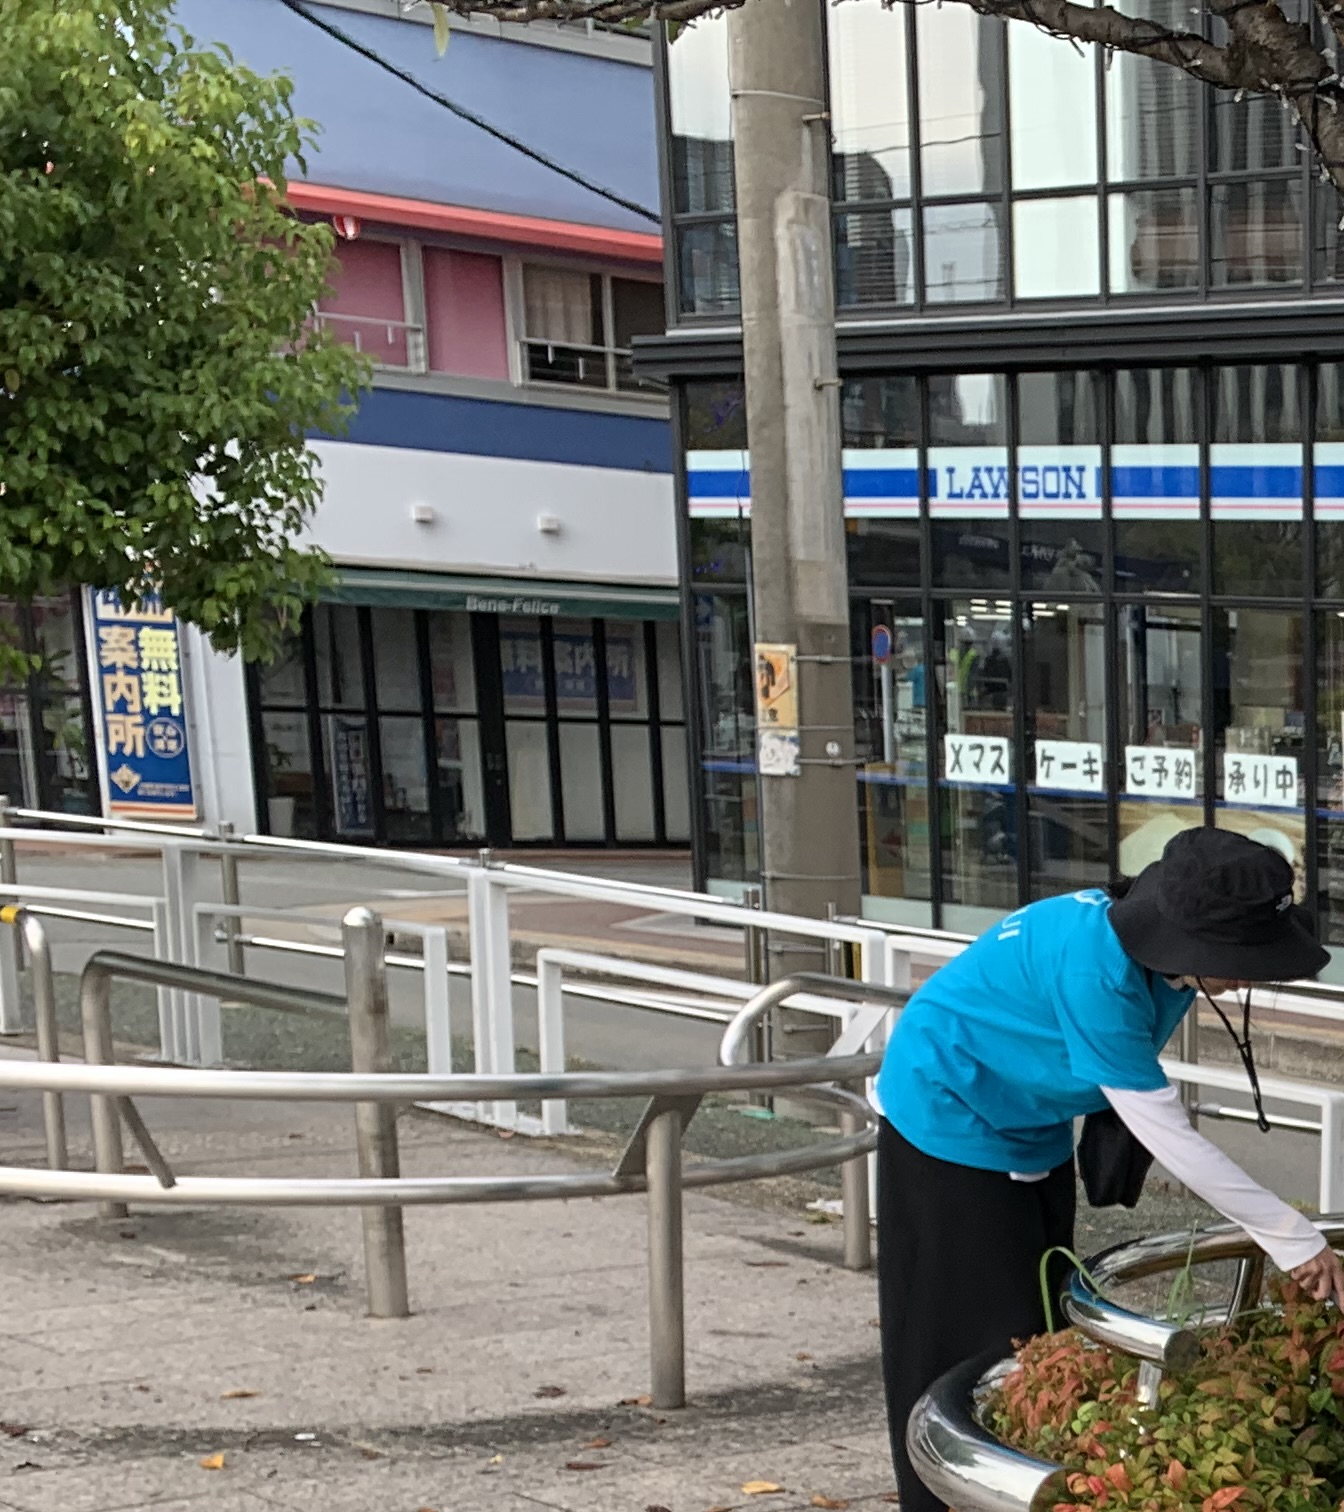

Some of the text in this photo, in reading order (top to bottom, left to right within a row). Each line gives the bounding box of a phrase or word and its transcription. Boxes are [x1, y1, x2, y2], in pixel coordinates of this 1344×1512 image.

[946, 465, 1087, 499] LAWSON
[99, 624, 146, 759] 案内所
[138, 626, 182, 717] 無料
[1039, 749, 1101, 784] ケーキ
[1129, 754, 1193, 791] ご予約
[1228, 761, 1295, 799] 承り中
